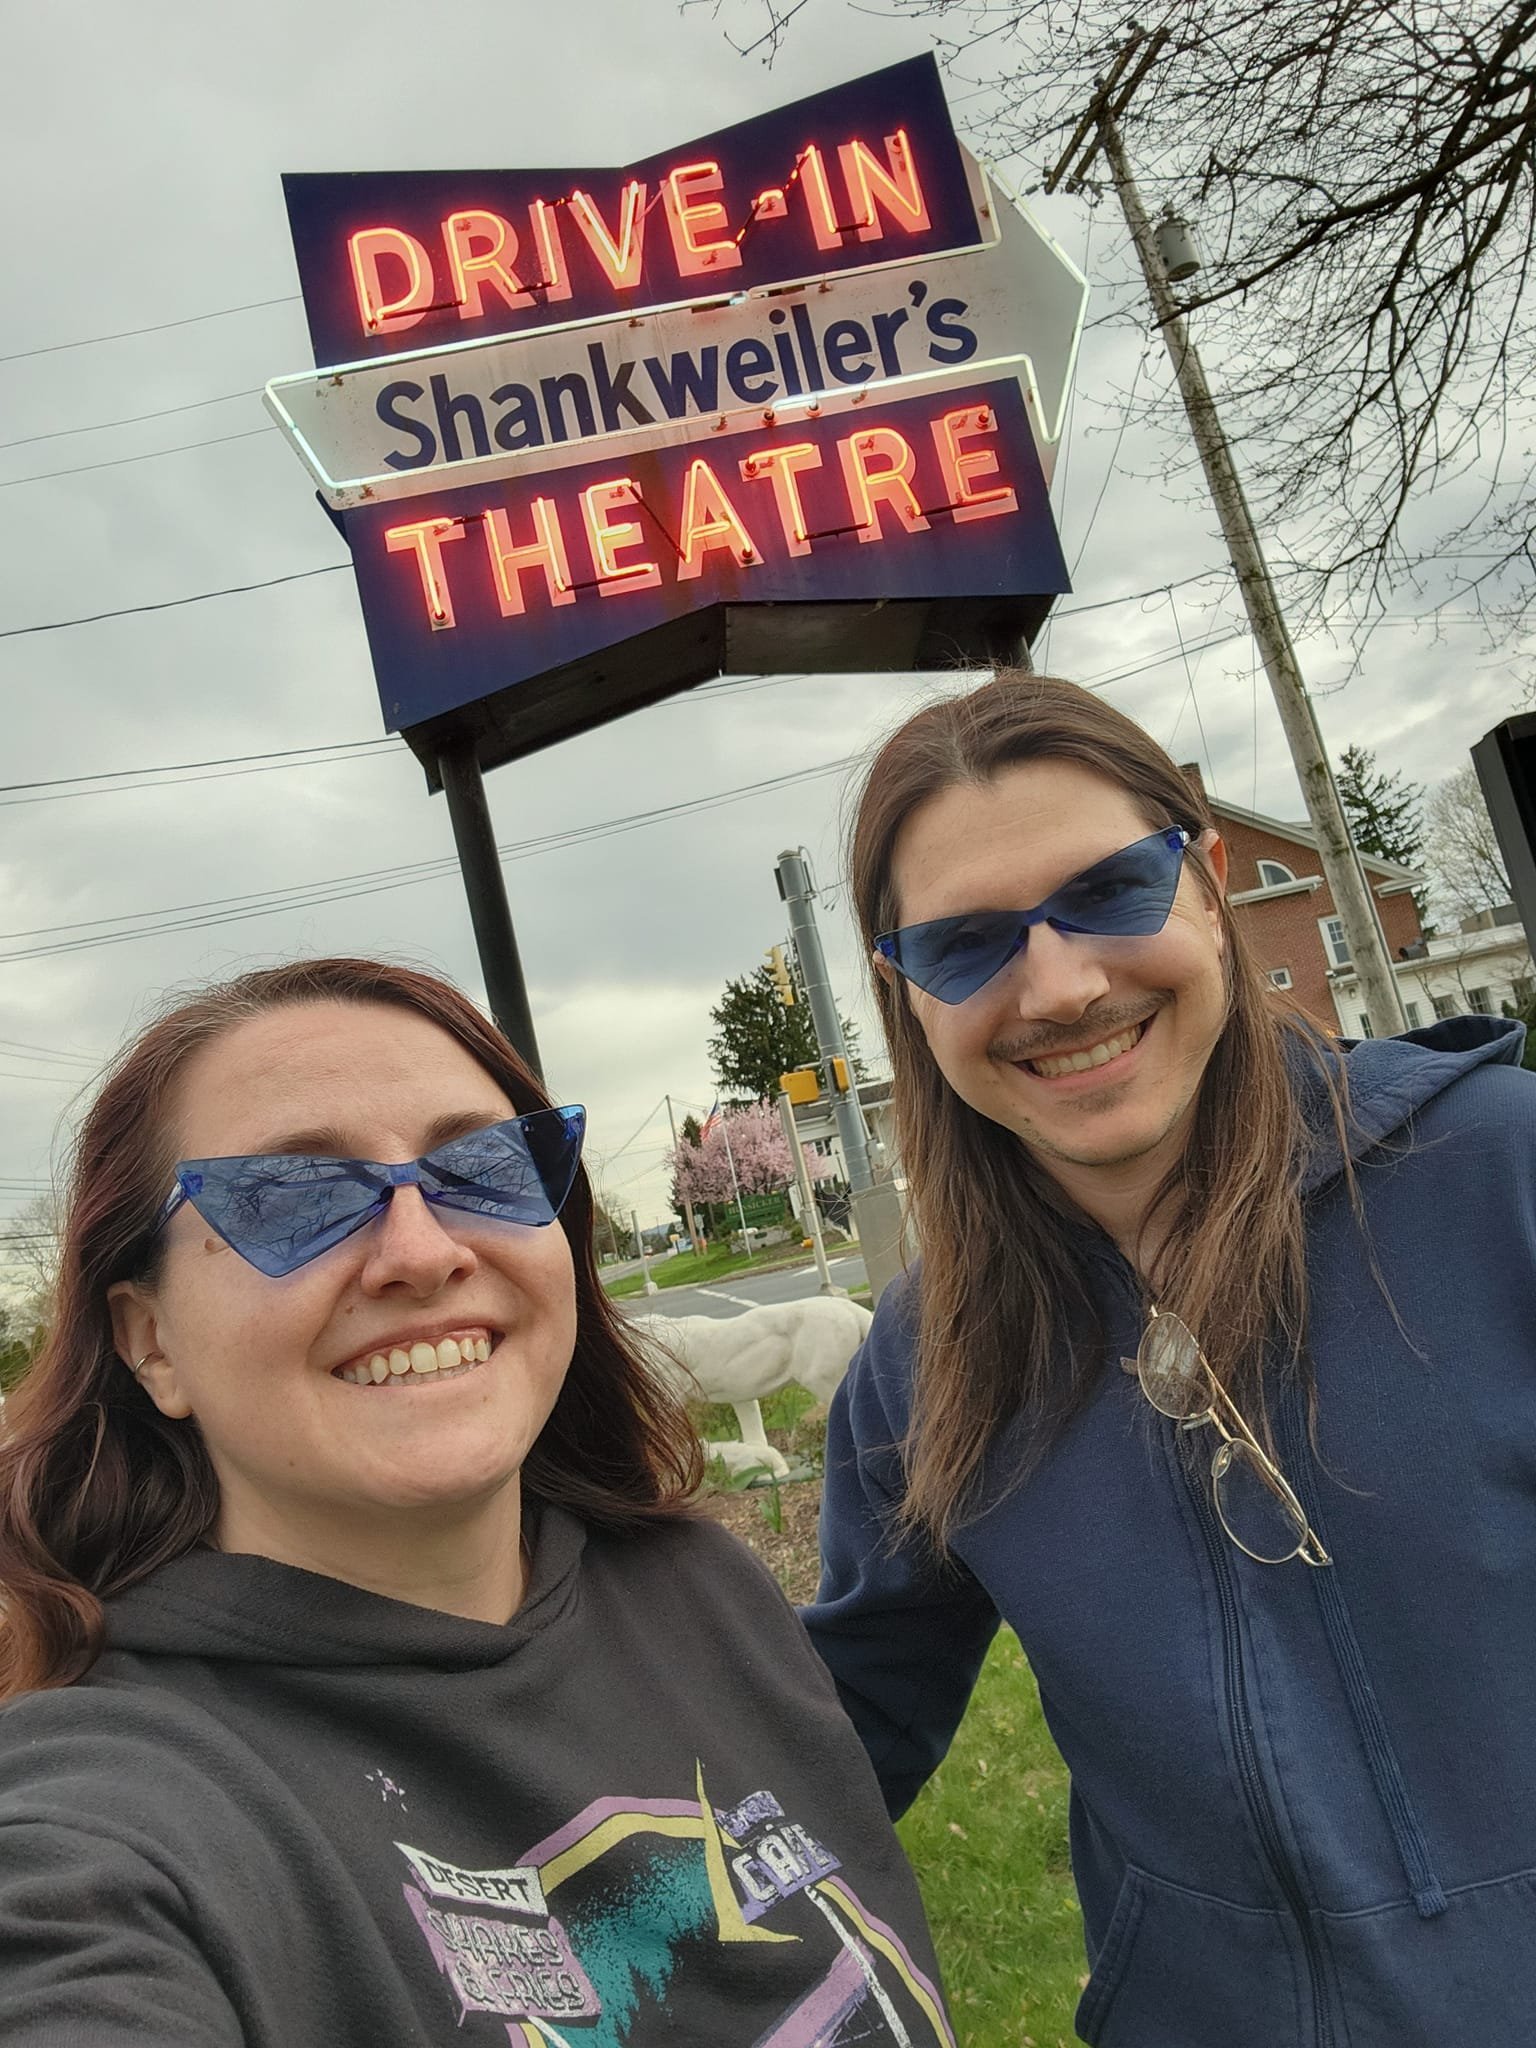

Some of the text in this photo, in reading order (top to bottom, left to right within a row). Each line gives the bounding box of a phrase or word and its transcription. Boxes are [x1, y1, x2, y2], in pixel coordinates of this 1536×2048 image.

[347, 128, 933, 338] DRIVE-IN
[375, 280, 978, 472] Shankweiler's
[384, 404, 1019, 632] THEATRE
[420, 1857, 533, 1904] DESERT
[732, 1822, 831, 1903] CAFE
[426, 1909, 565, 1969] SHAKES
[487, 1966, 586, 2011] FRIES
